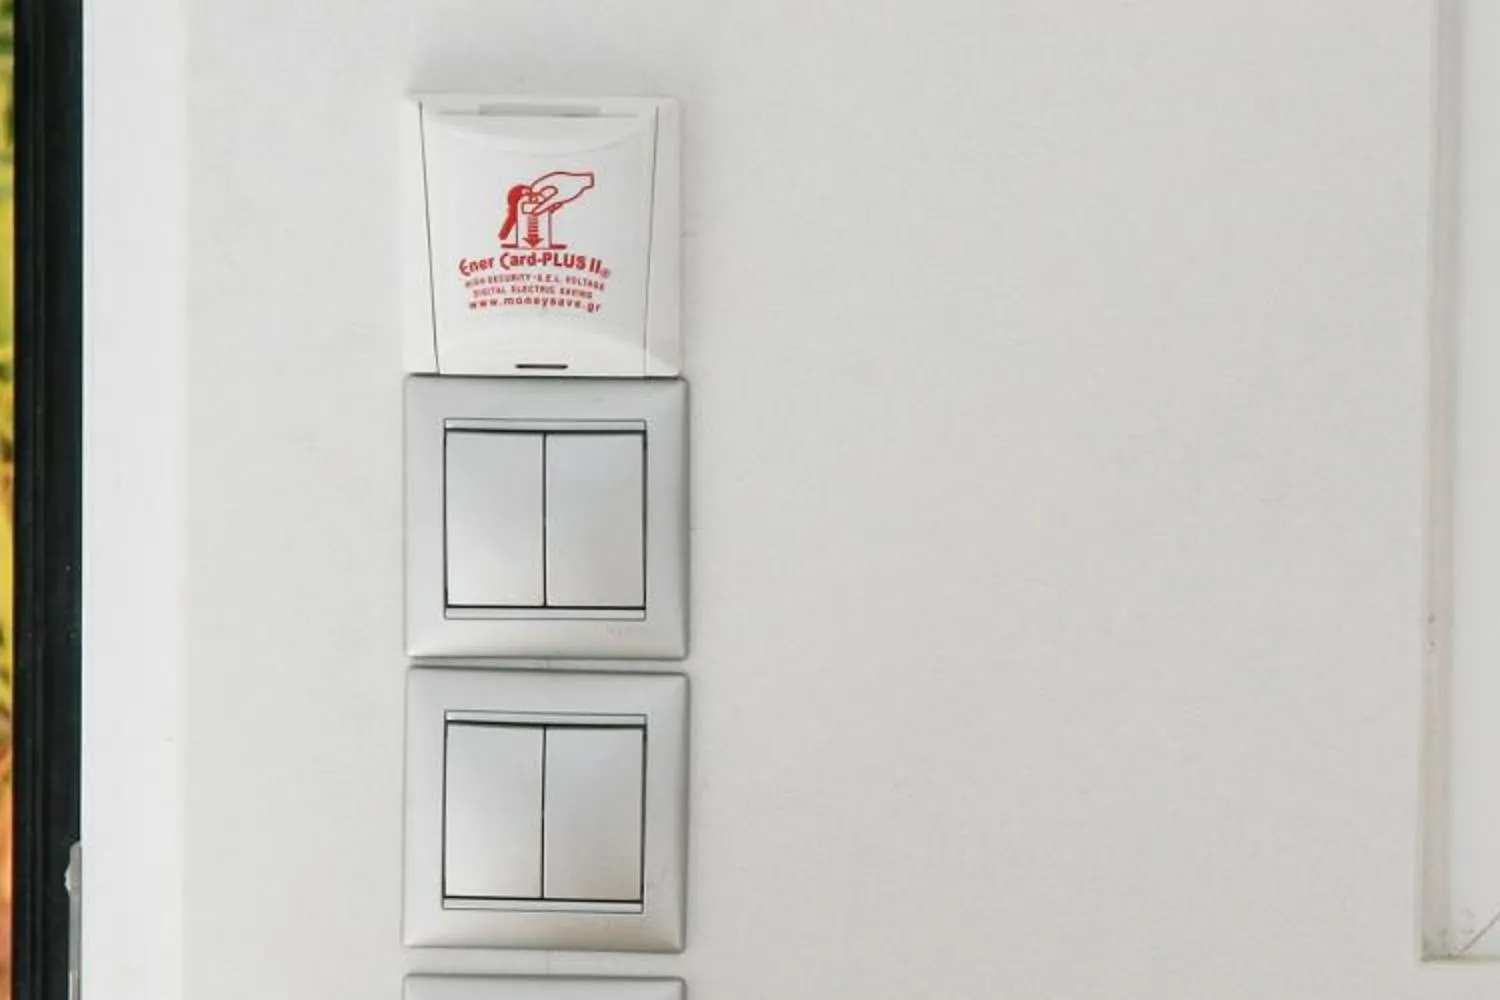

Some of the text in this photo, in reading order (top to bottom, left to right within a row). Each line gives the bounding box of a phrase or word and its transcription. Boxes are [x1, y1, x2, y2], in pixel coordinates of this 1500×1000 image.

[458, 256, 495, 277] Ener
[500, 252, 587, 271] Card-PLUS
[565, 276, 606, 291] VOLTAGE
[473, 285, 594, 299] DIGITAL ELECTRIC SAVING
[469, 297, 602, 313] www.moneysave.gr
